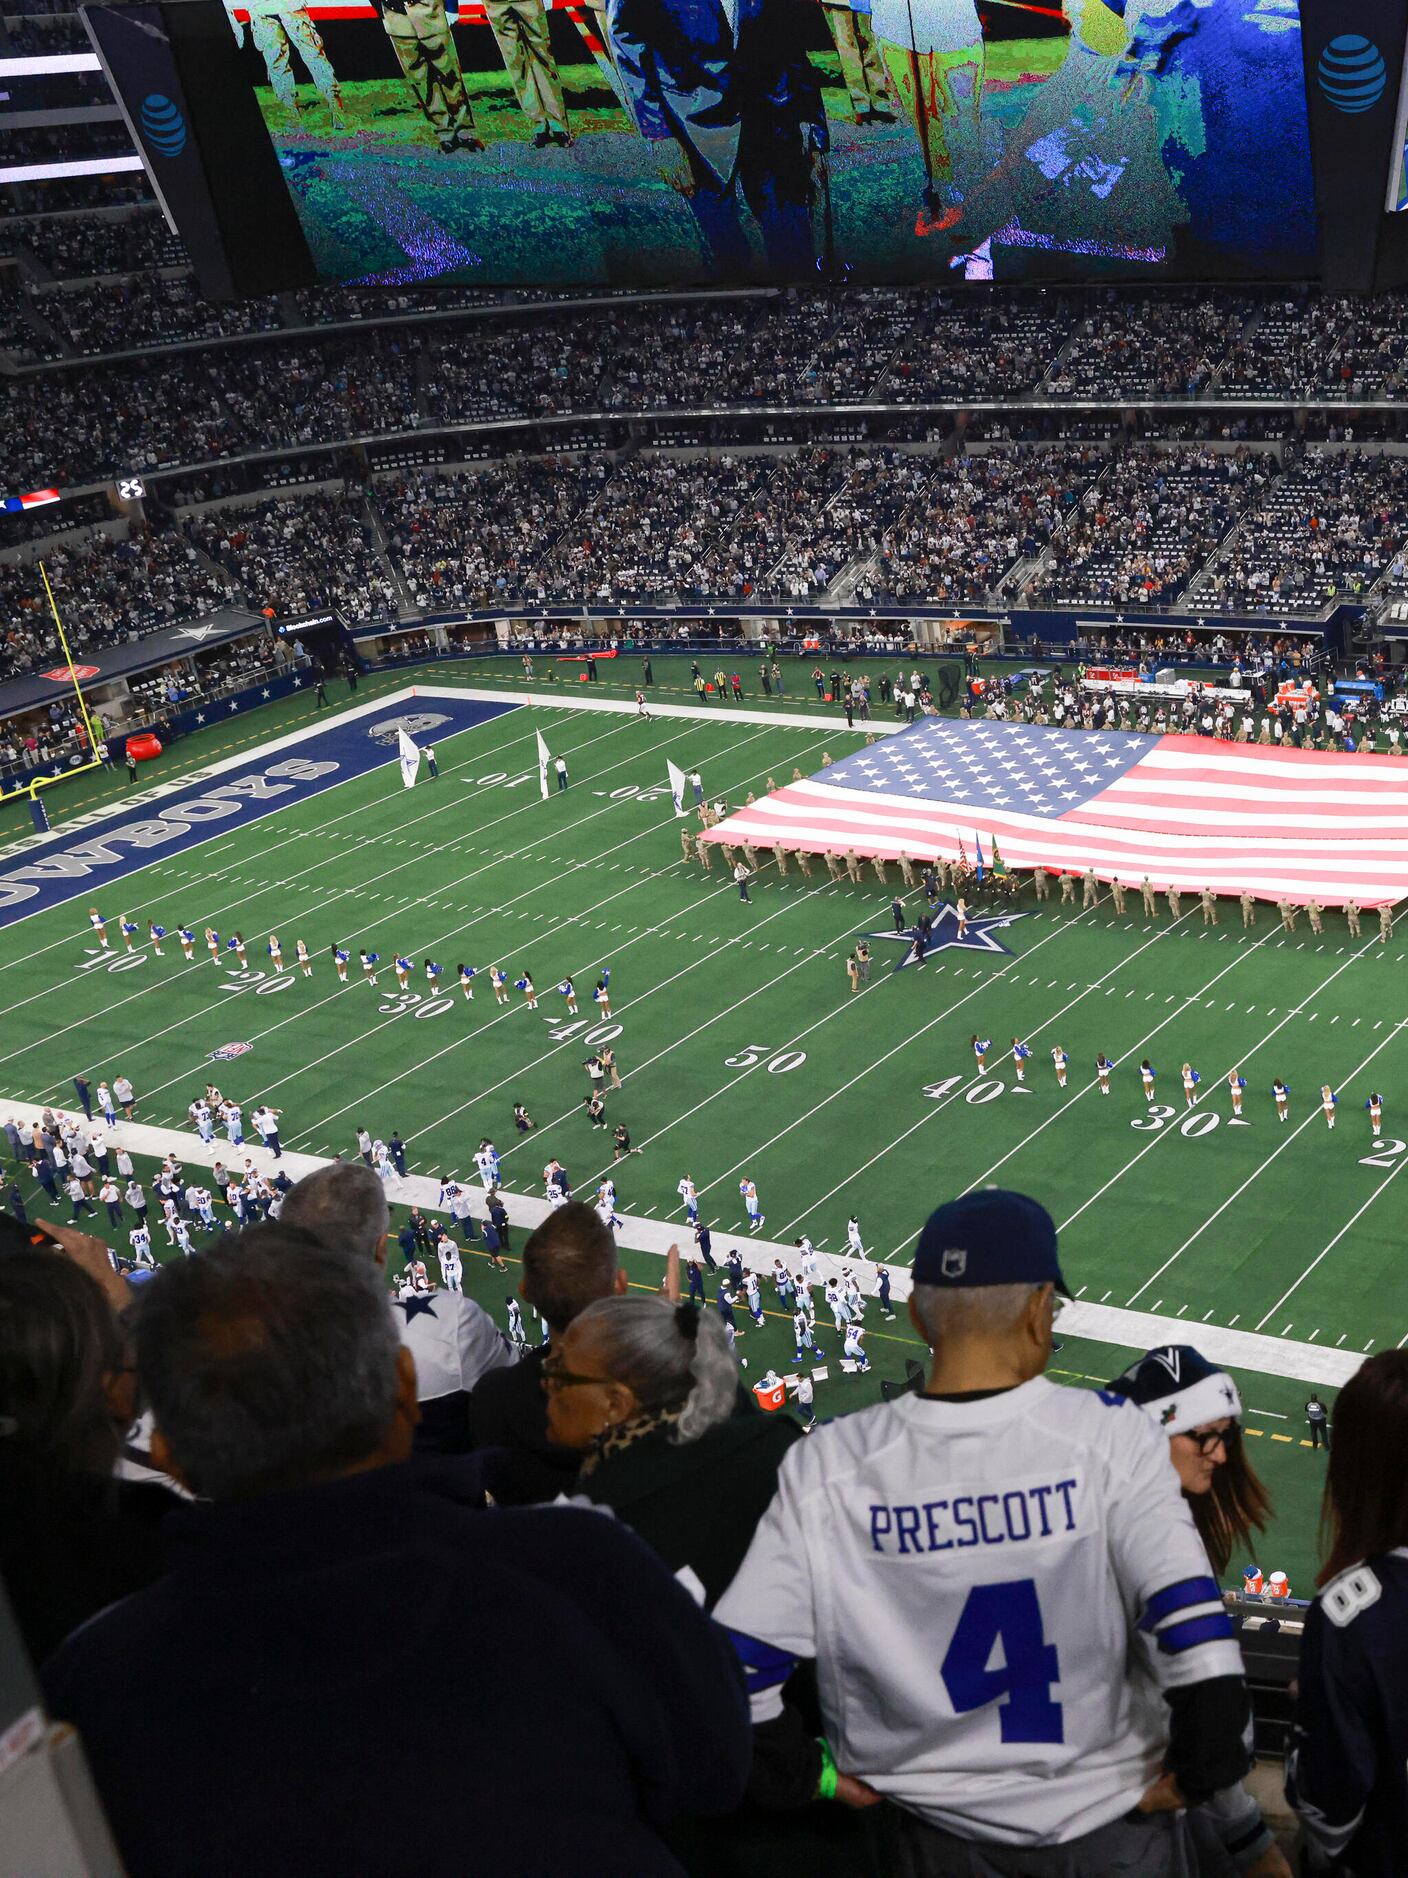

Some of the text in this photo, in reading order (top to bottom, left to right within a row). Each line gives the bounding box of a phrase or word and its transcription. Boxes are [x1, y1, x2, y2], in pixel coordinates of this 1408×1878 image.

[120, 479, 143, 499] 25
[285, 615, 333, 632] Blockchain.com
[476, 772, 537, 788] 10
[54, 809, 117, 835] ALL
[120, 790, 163, 807] OF
[168, 771, 212, 788] US
[609, 785, 674, 802] 20
[74, 950, 148, 973] 10
[217, 971, 296, 995] 20
[378, 993, 455, 1019] 30
[547, 1019, 625, 1046] 40
[724, 1044, 808, 1074] 50
[921, 1074, 1006, 1105] 40
[1130, 1104, 1221, 1138] 30
[481, 1157, 487, 1167] 4
[134, 1233, 146, 1245] 34
[846, 1327, 859, 1340] 54
[771, 1391, 783, 1404] G
[869, 1478, 1077, 1554] PRESCOTT
[940, 1577, 1065, 1745] 4
